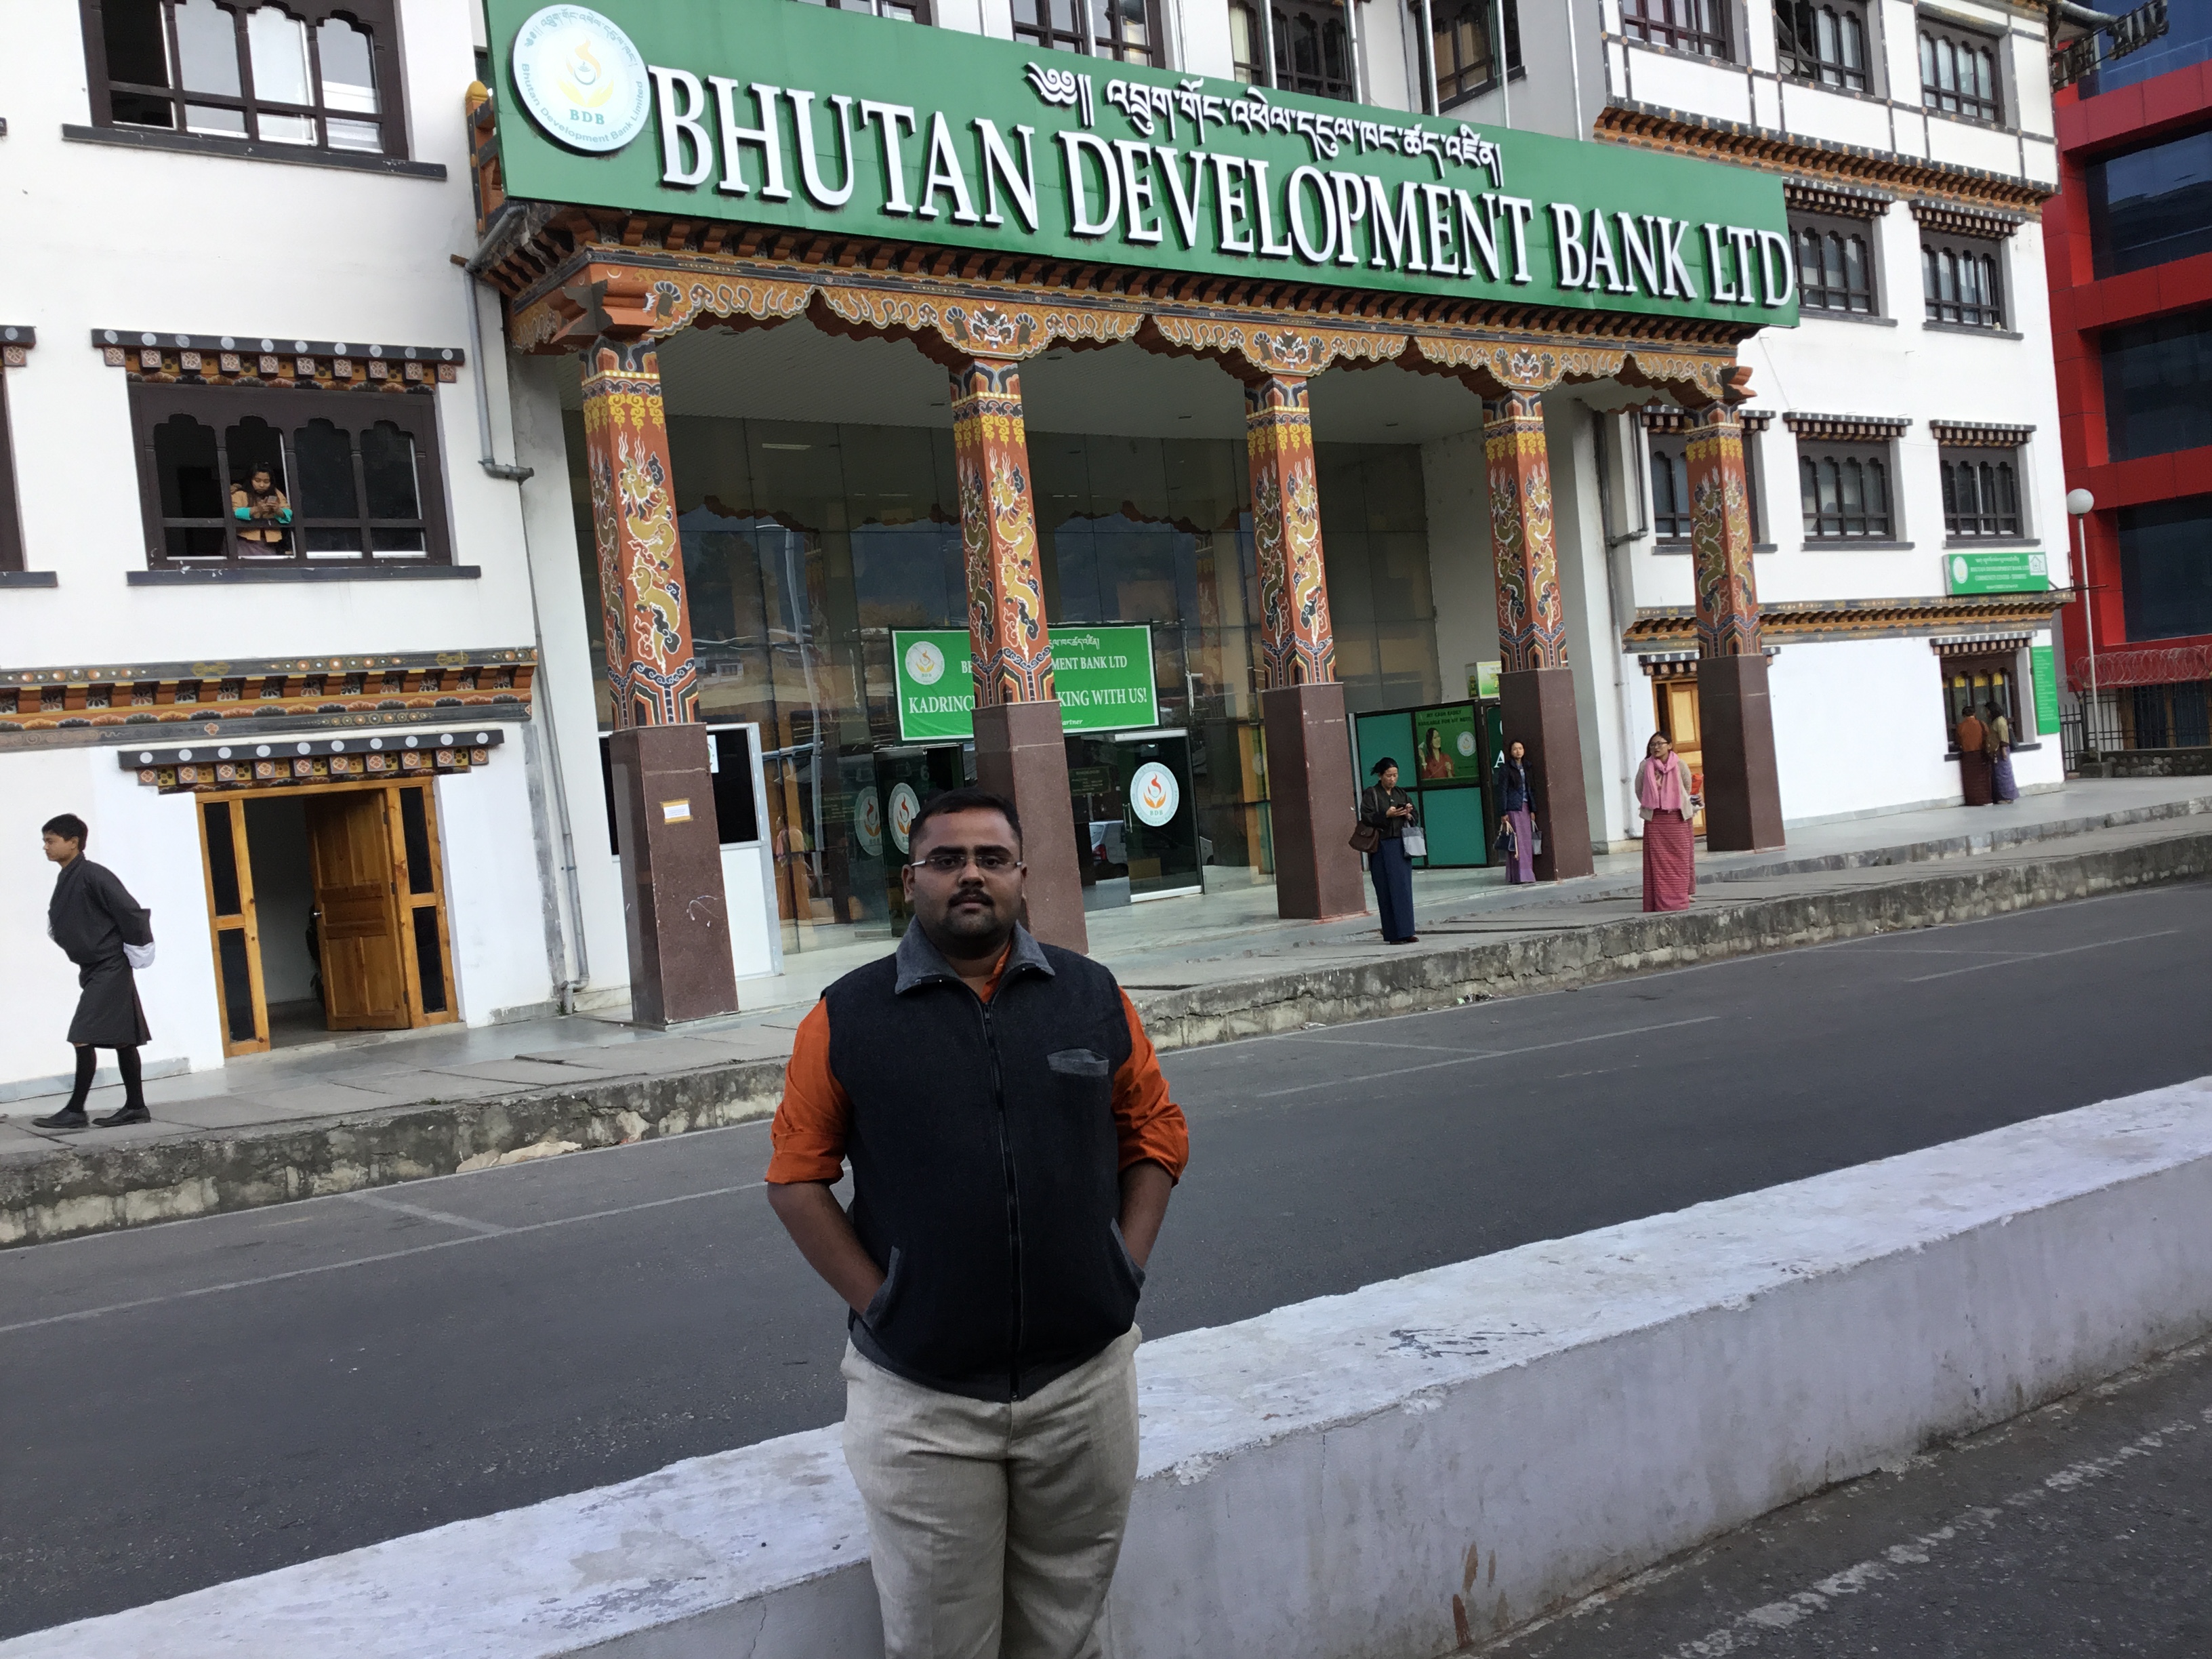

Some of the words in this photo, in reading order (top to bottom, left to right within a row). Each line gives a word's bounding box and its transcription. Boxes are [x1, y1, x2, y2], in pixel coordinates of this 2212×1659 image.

[521, 63, 540, 106] Bhutan
[540, 108, 609, 143] Development
[611, 121, 633, 140] Bank
[630, 81, 644, 121] Limited
[569, 109, 605, 125] BDB
[648, 65, 1038, 230] BHUTAN
[1057, 130, 1532, 282] DEVELOPMENT
[1551, 202, 1698, 299] BANK
[1704, 222, 1794, 306] LTD
[1052, 657, 1078, 670] MENT
[1080, 656, 1107, 669] BANK
[1109, 655, 1128, 668] LTD
[908, 695, 975, 714] KADRINC
[1056, 690, 1090, 707] KING
[1091, 688, 1126, 704] WITH
[1128, 687, 1147, 703] US!
